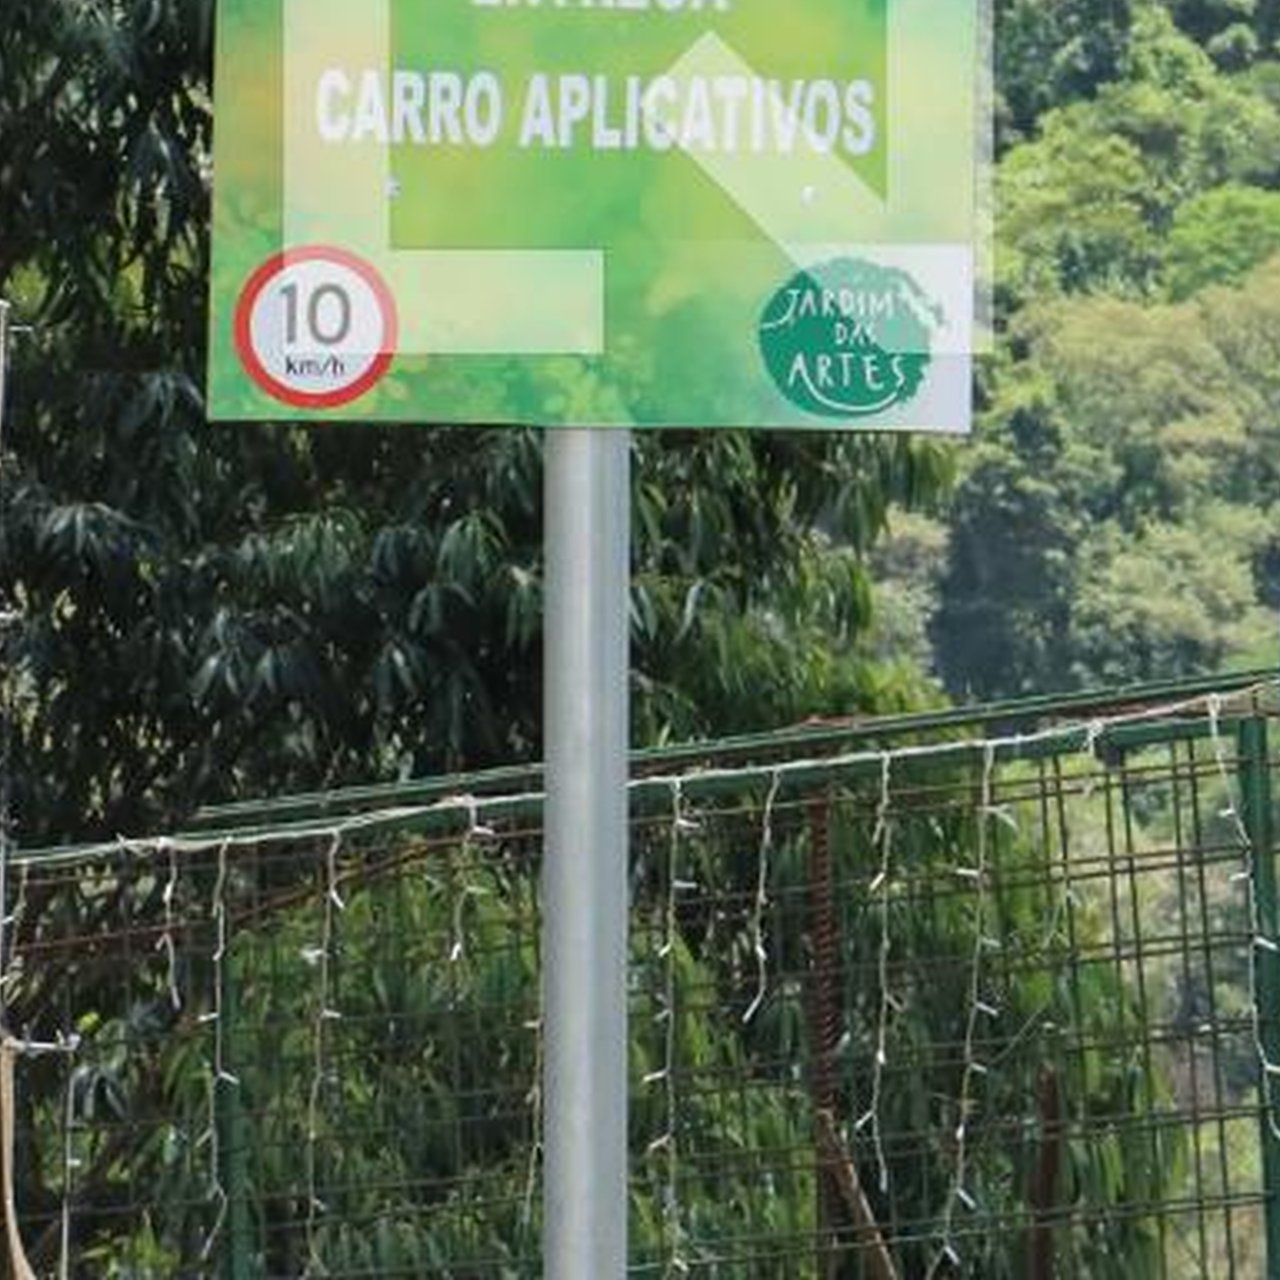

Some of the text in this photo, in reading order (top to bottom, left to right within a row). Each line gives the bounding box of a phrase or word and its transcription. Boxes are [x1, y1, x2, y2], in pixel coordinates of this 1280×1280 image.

[317, 68, 874, 156] CARRO APLICATIVOS
[280, 282, 351, 345] 10
[761, 288, 894, 329] JARDIM
[286, 355, 344, 376] km/h
[788, 352, 906, 411] ARTES
